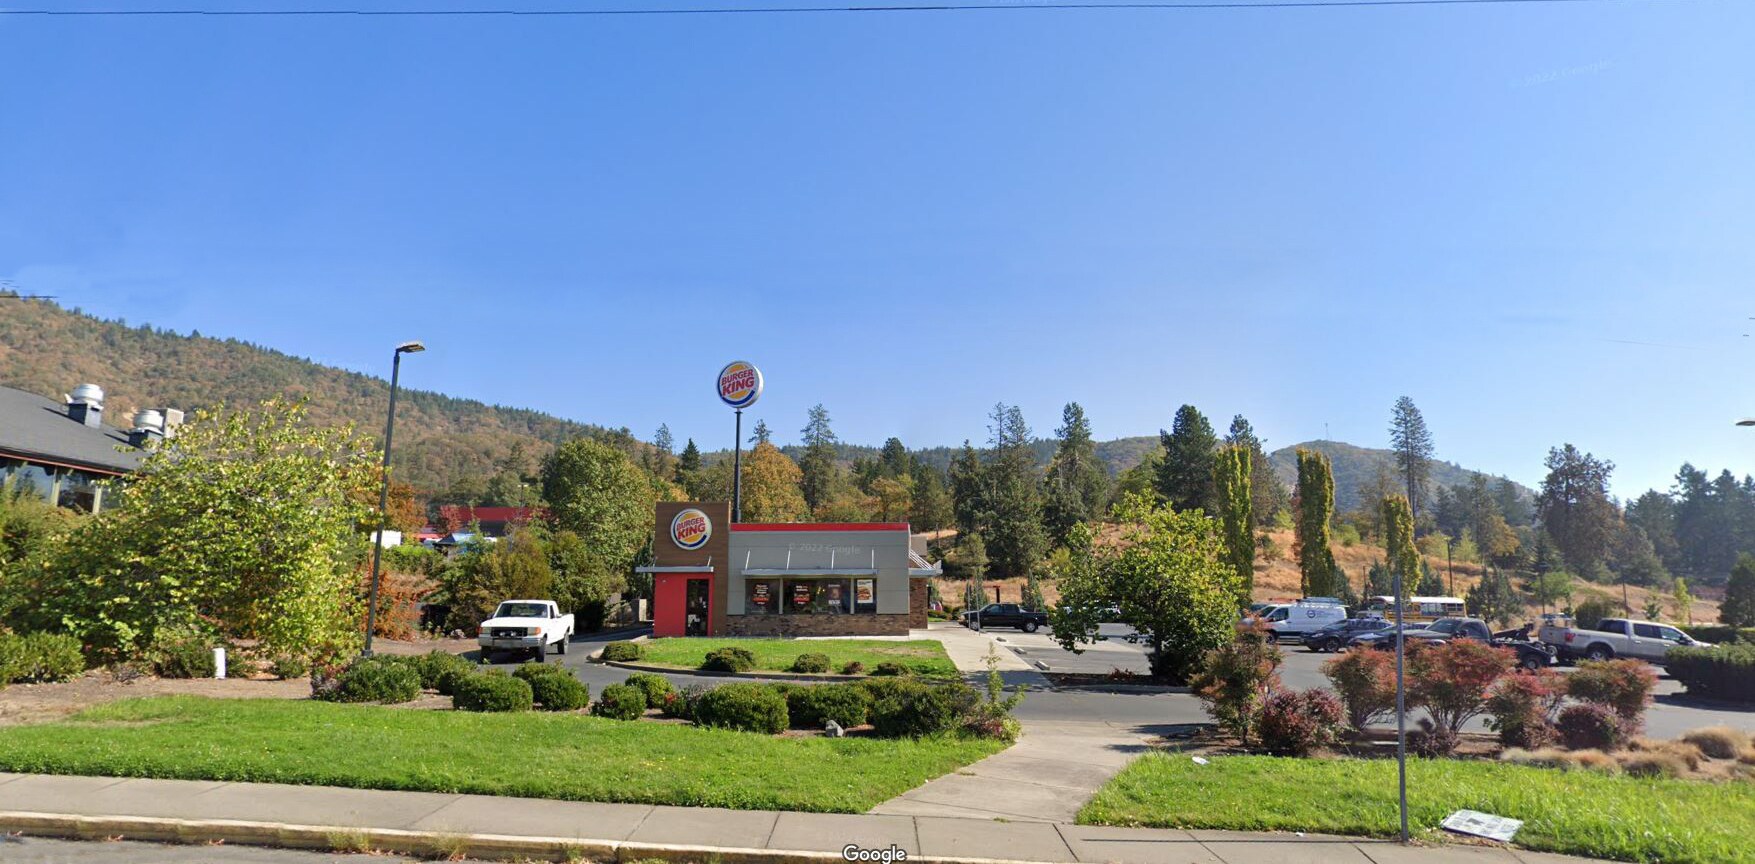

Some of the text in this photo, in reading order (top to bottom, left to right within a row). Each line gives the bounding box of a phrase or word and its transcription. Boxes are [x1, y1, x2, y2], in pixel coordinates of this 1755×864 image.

[721, 369, 754, 386] BURGER
[722, 376, 755, 396] KING
[676, 516, 705, 531] BURGER
[677, 522, 706, 540] KING
